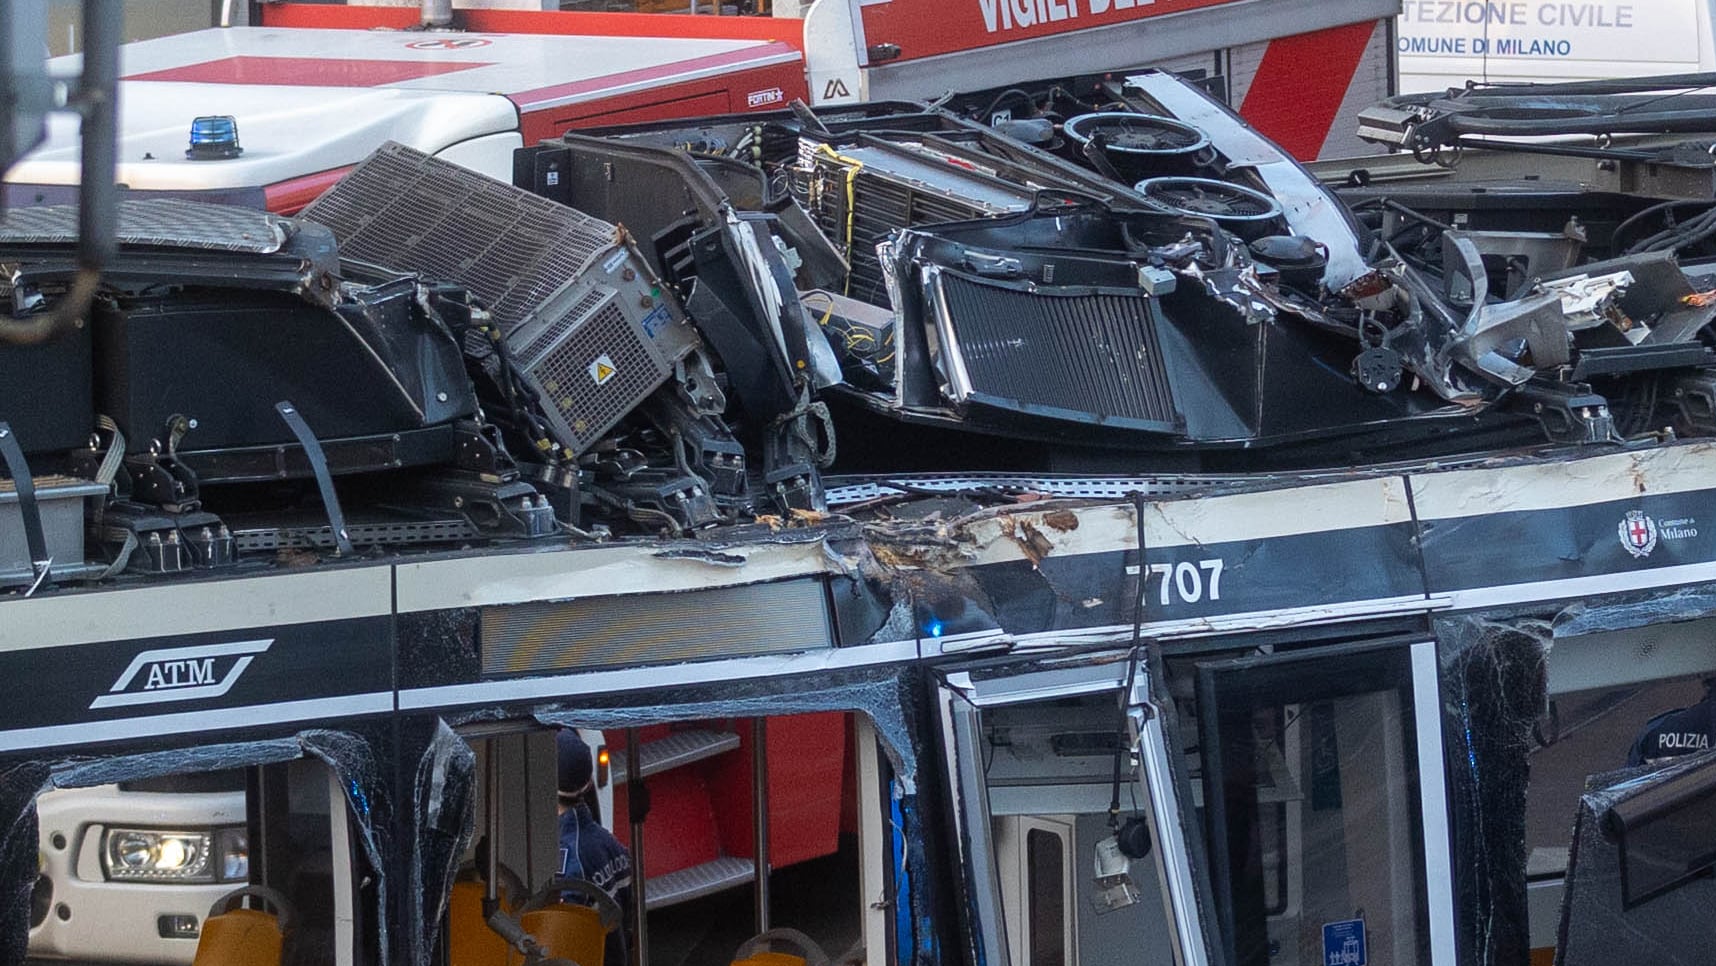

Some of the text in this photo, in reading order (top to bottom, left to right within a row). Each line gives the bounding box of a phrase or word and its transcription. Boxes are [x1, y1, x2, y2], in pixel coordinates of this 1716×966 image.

[1403, 0, 1634, 28] TEZIONE CIVILE
[1398, 36, 1571, 56] OMUNE DI MILANO
[1660, 527, 1698, 540] Milano
[144, 658, 216, 690] ATM
[1659, 732, 1709, 749] POLIZIA
